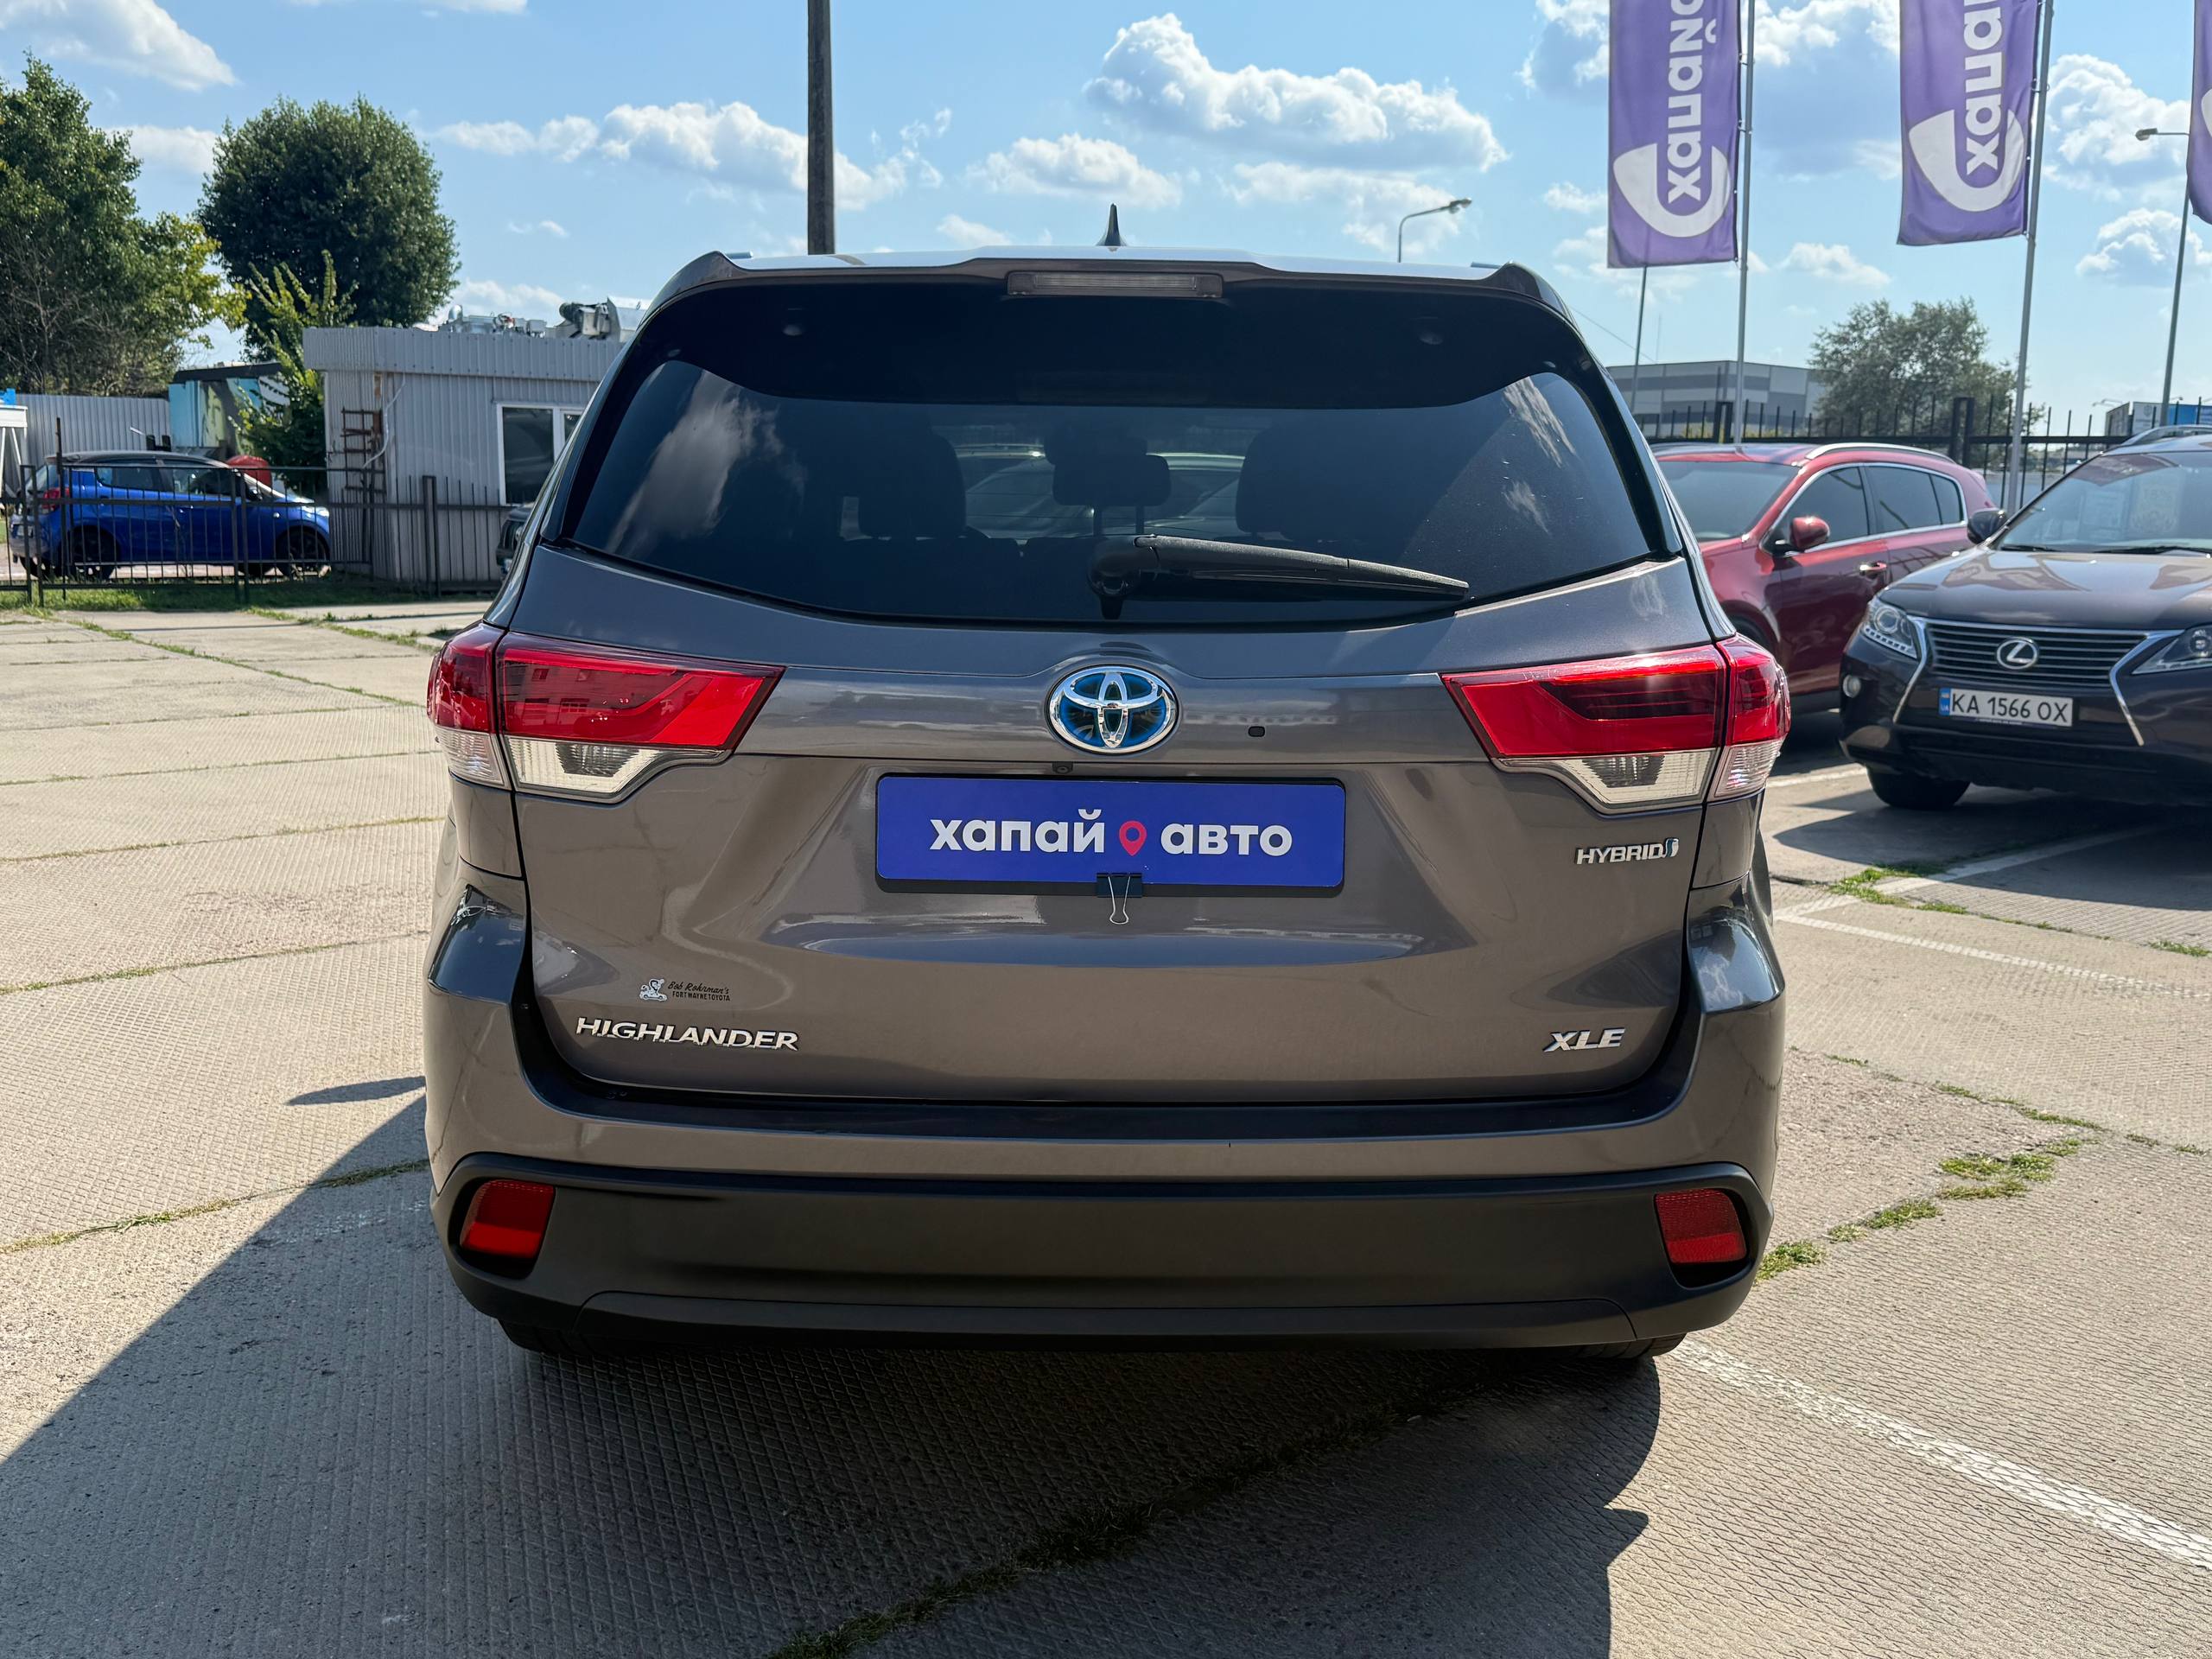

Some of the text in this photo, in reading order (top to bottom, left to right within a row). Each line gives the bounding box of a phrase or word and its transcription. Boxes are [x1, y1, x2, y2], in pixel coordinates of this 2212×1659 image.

[1963, 0, 2003, 175] хапа
[1951, 693, 2069, 722] KA 1566 OX
[930, 808, 1293, 857] хапай авто
[1576, 842, 1665, 865] HYBRID
[668, 981, 684, 990] Bob
[688, 992, 708, 1001] WAYNE
[575, 1016, 799, 1051] HIGHLANDER
[1543, 1028, 1625, 1052] XLE
